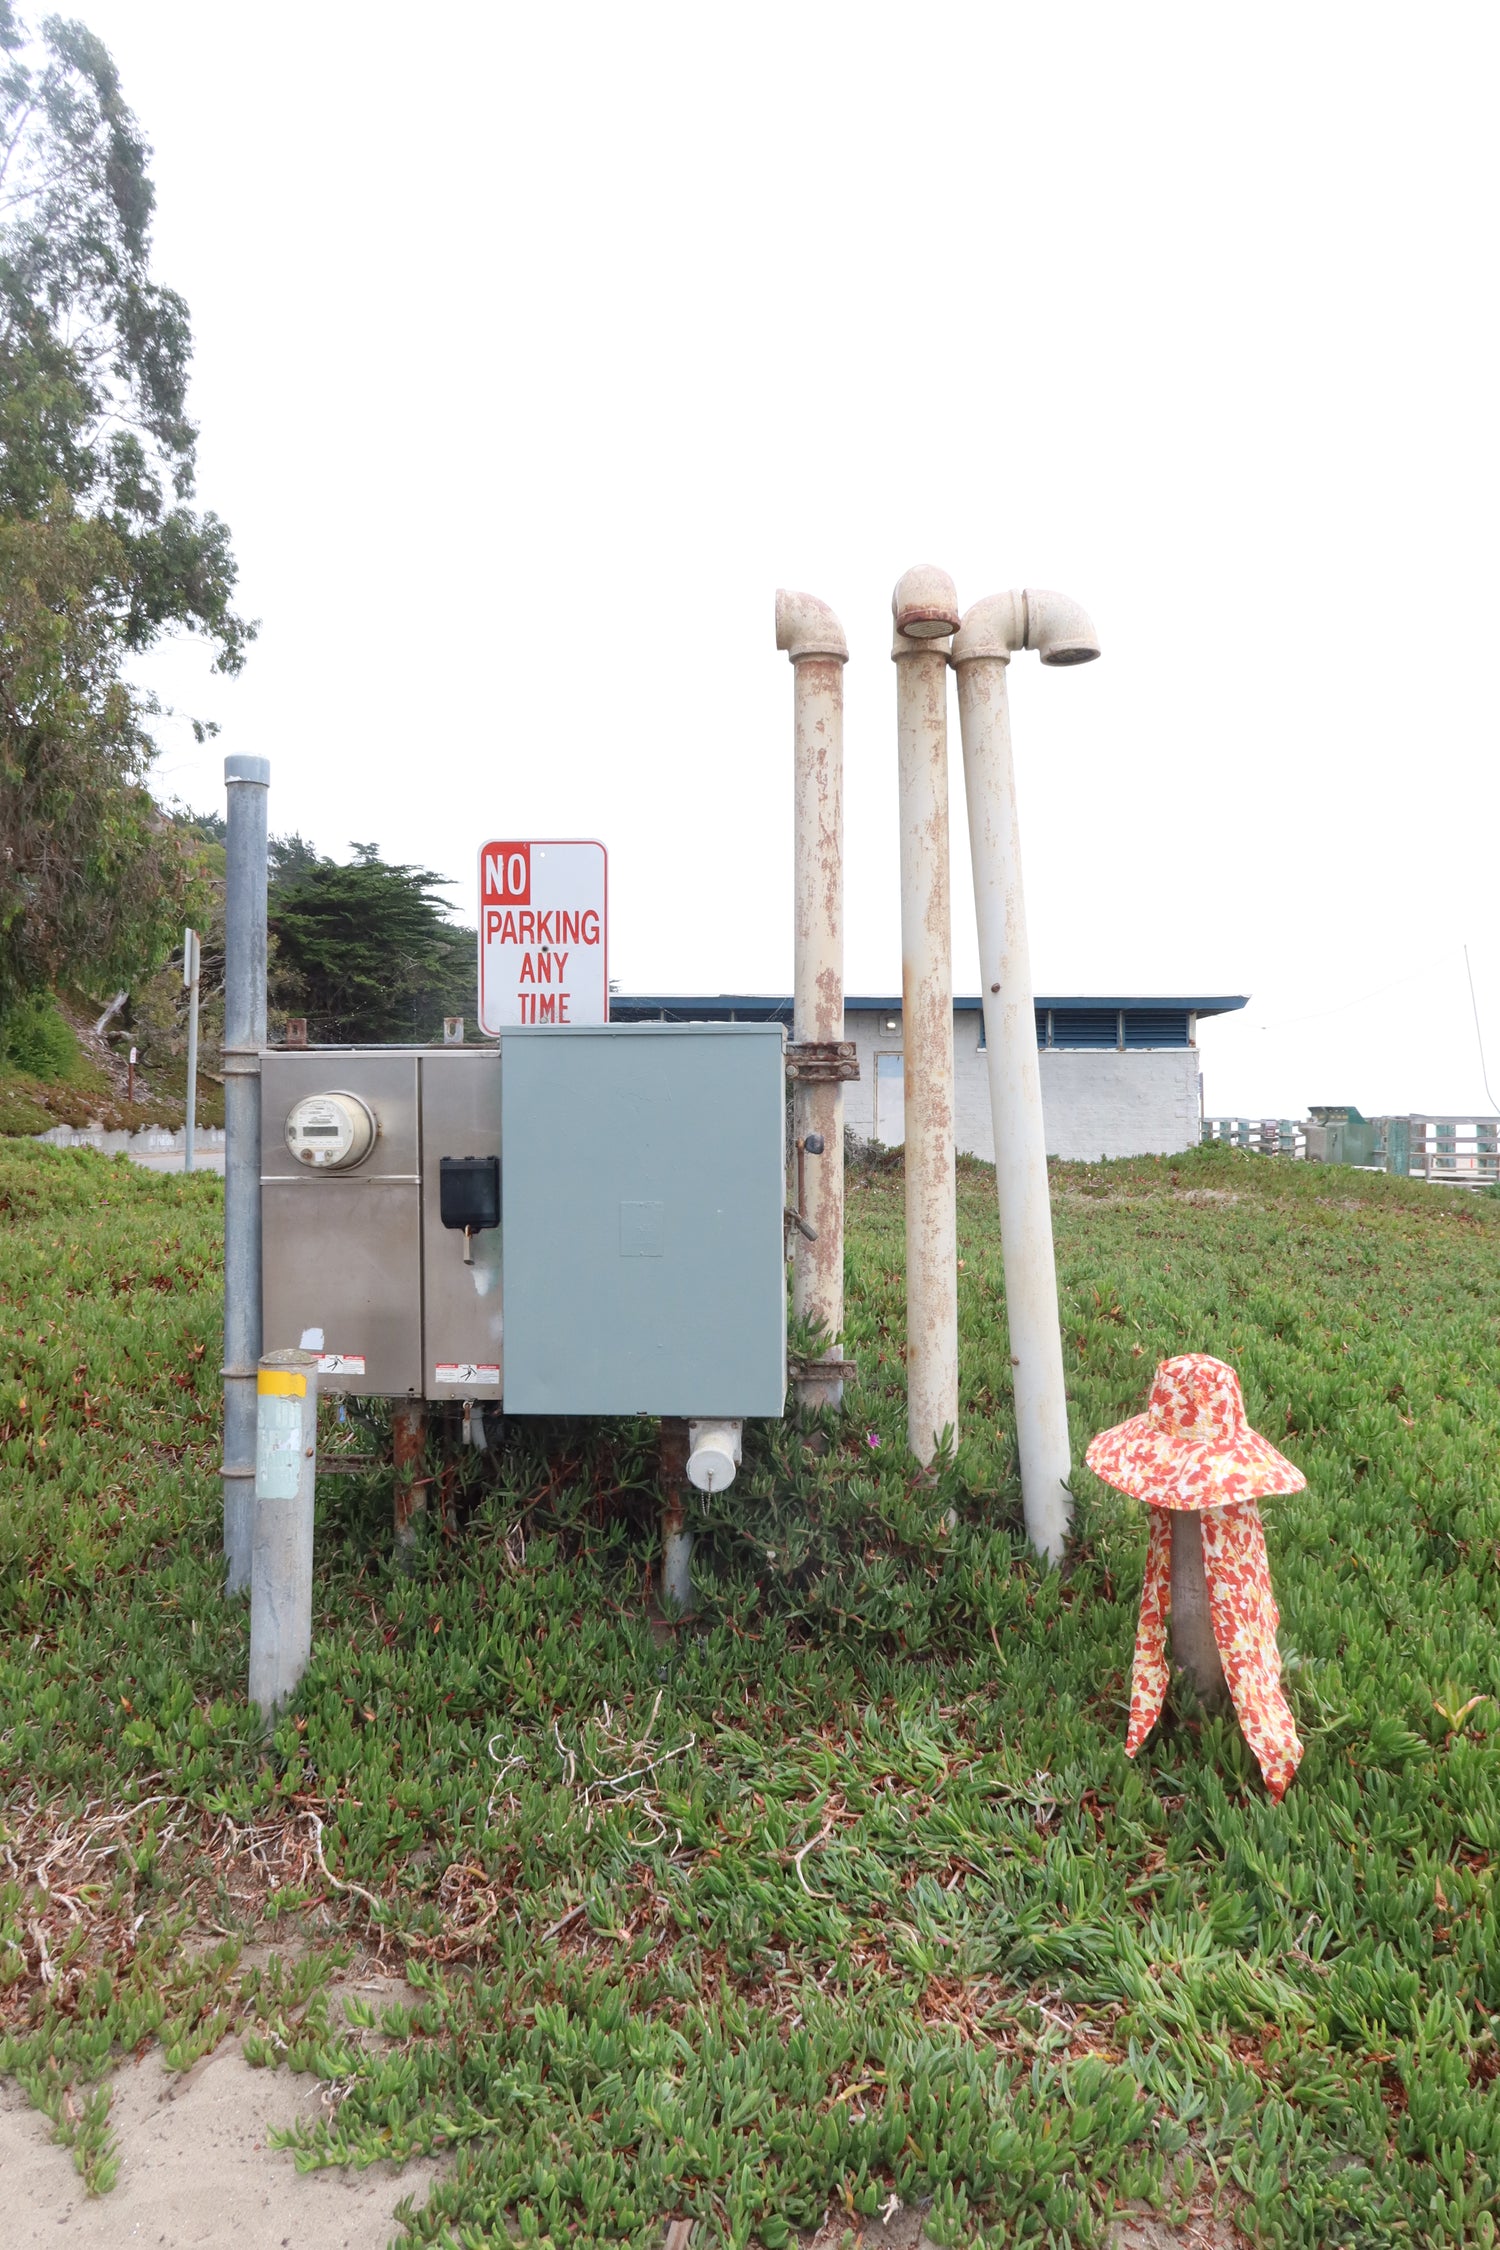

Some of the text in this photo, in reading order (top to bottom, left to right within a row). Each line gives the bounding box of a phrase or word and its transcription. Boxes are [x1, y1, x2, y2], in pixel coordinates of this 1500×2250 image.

[485, 854, 527, 895] NO
[487, 910, 600, 945] PARKING
[519, 952, 569, 984] ANY
[518, 993, 571, 1024] TIME
